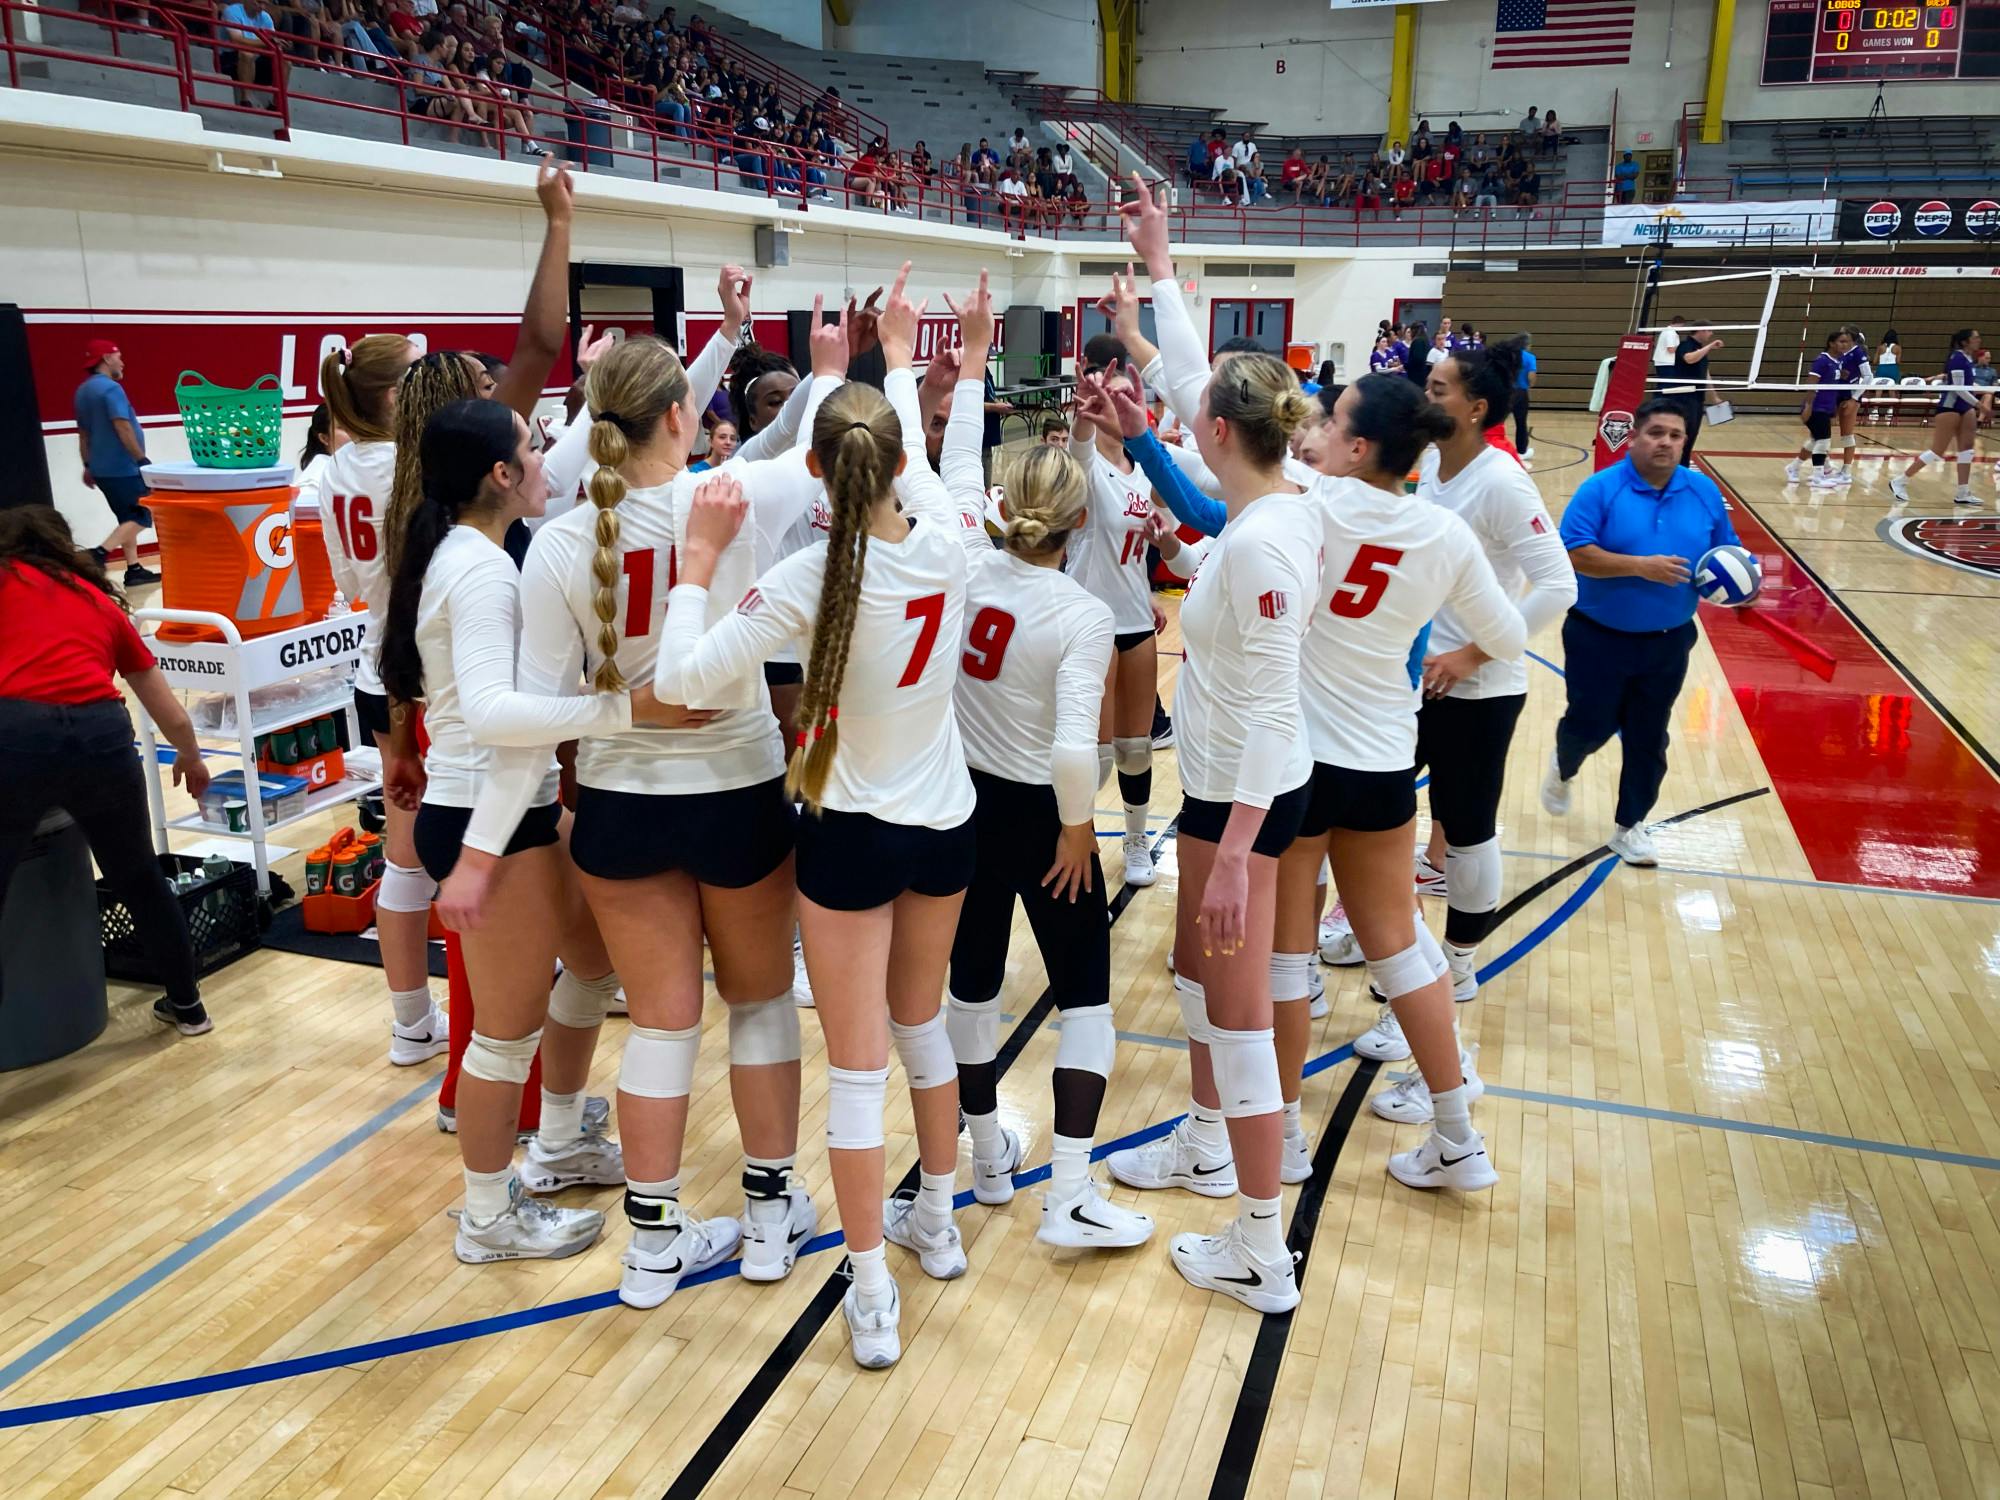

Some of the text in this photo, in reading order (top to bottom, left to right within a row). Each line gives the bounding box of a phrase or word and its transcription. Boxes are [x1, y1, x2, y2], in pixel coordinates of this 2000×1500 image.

[1828, 0, 1861, 9] LOBOS
[1840, 8, 1953, 29] 0 0:02 0
[1836, 29, 1939, 50] 0 GAMES WON 0
[1276, 60, 1286, 74] B
[1633, 223, 1662, 236] NEW
[1662, 223, 1704, 236] EXICO
[1866, 215, 1899, 224] PEPSI
[1916, 214, 1950, 223] PEPSI
[254, 511, 294, 569] G
[333, 496, 377, 562] 16
[1120, 528, 1147, 565] 14
[623, 545, 678, 637] 1
[1329, 544, 1404, 618] 5
[897, 592, 945, 688] 7
[962, 607, 1016, 681] 9
[156, 656, 226, 676] ATORADE
[312, 760, 327, 784] G
